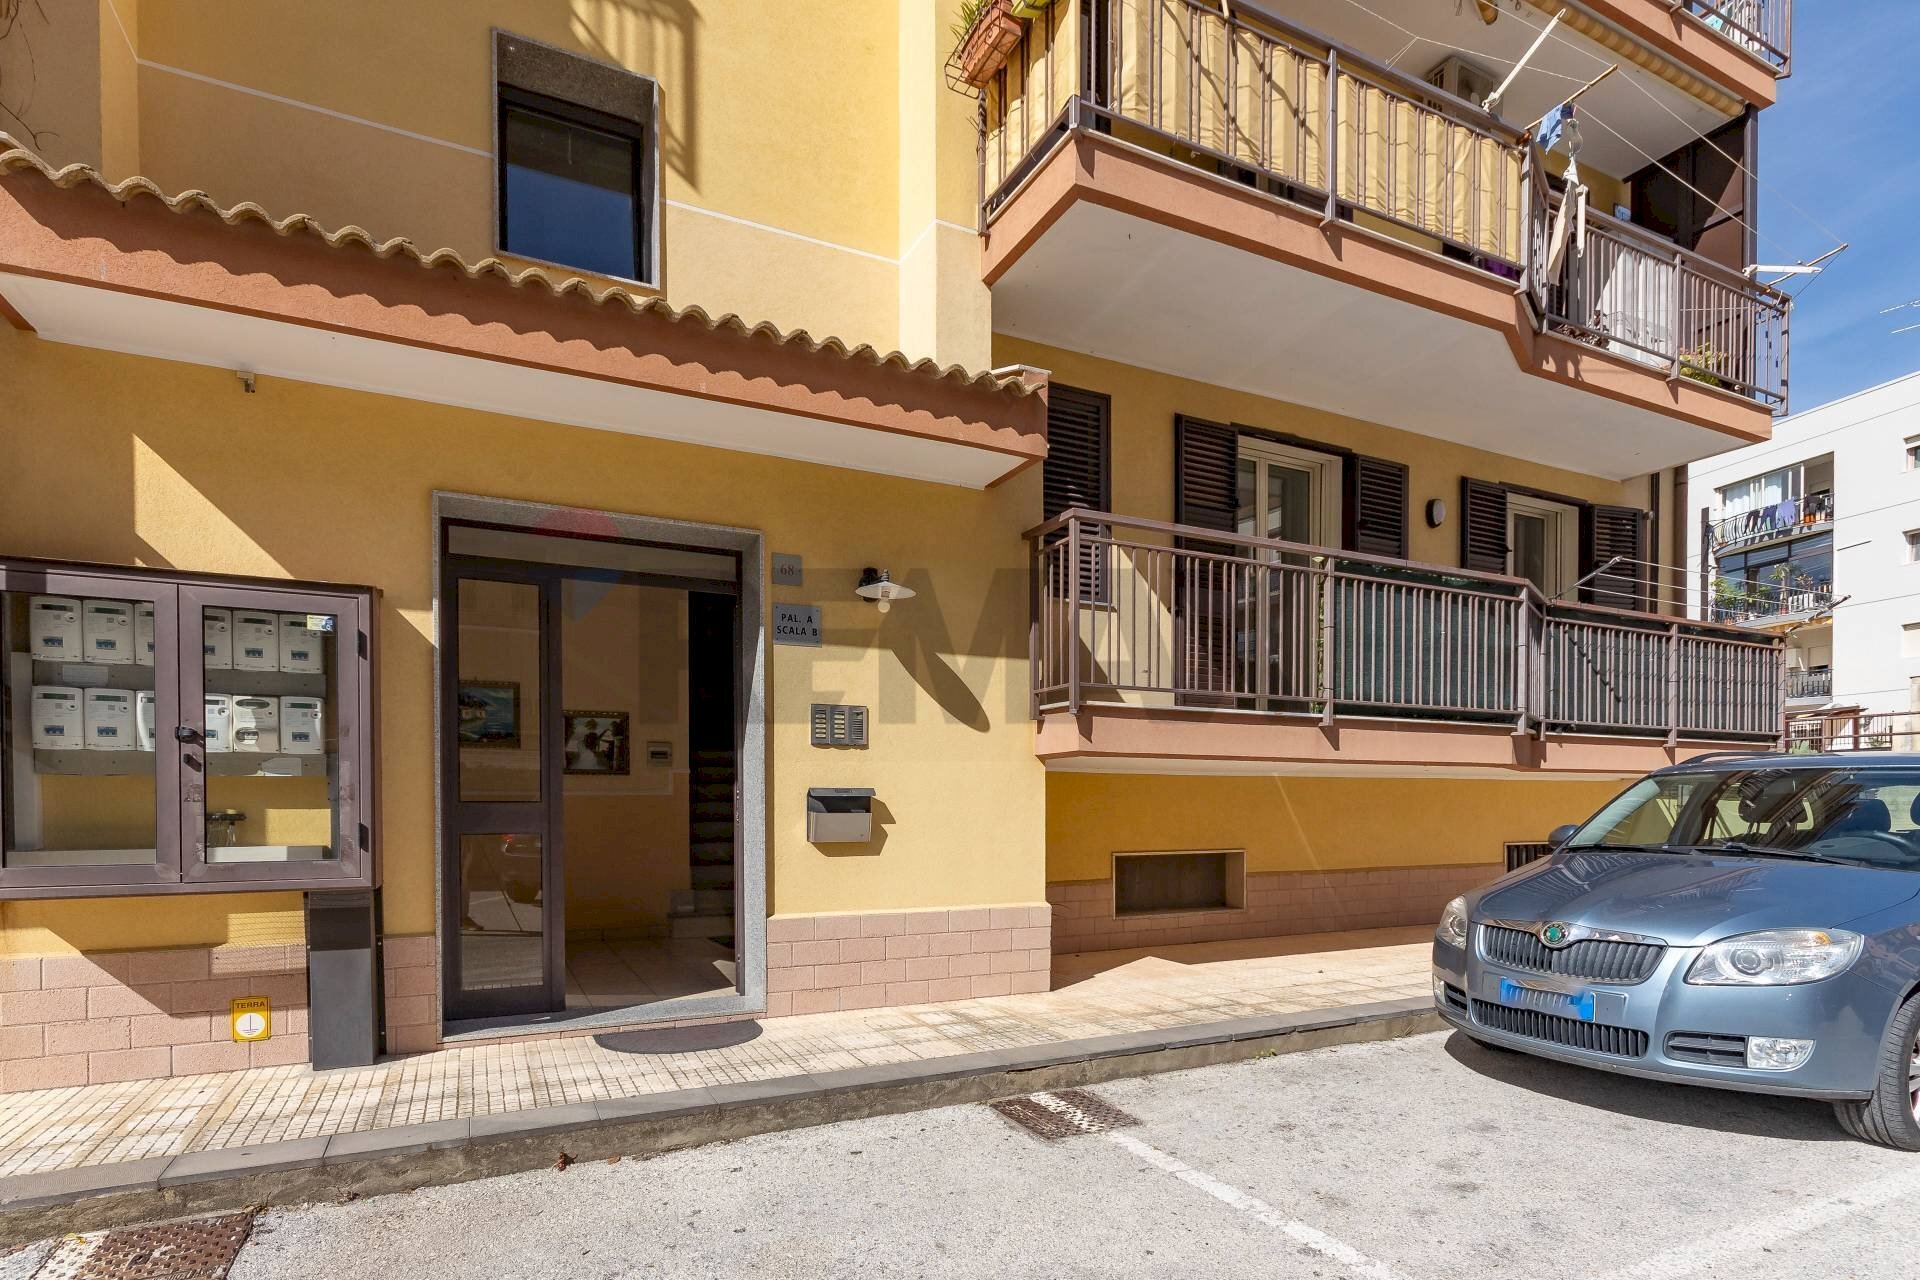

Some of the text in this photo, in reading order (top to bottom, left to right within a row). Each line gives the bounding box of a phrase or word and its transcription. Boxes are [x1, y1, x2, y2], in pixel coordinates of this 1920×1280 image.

[780, 564, 794, 576] 68
[781, 613, 813, 624] PAL. A
[776, 625, 818, 636] SCALA B
[235, 1001, 265, 1009] TERRA
